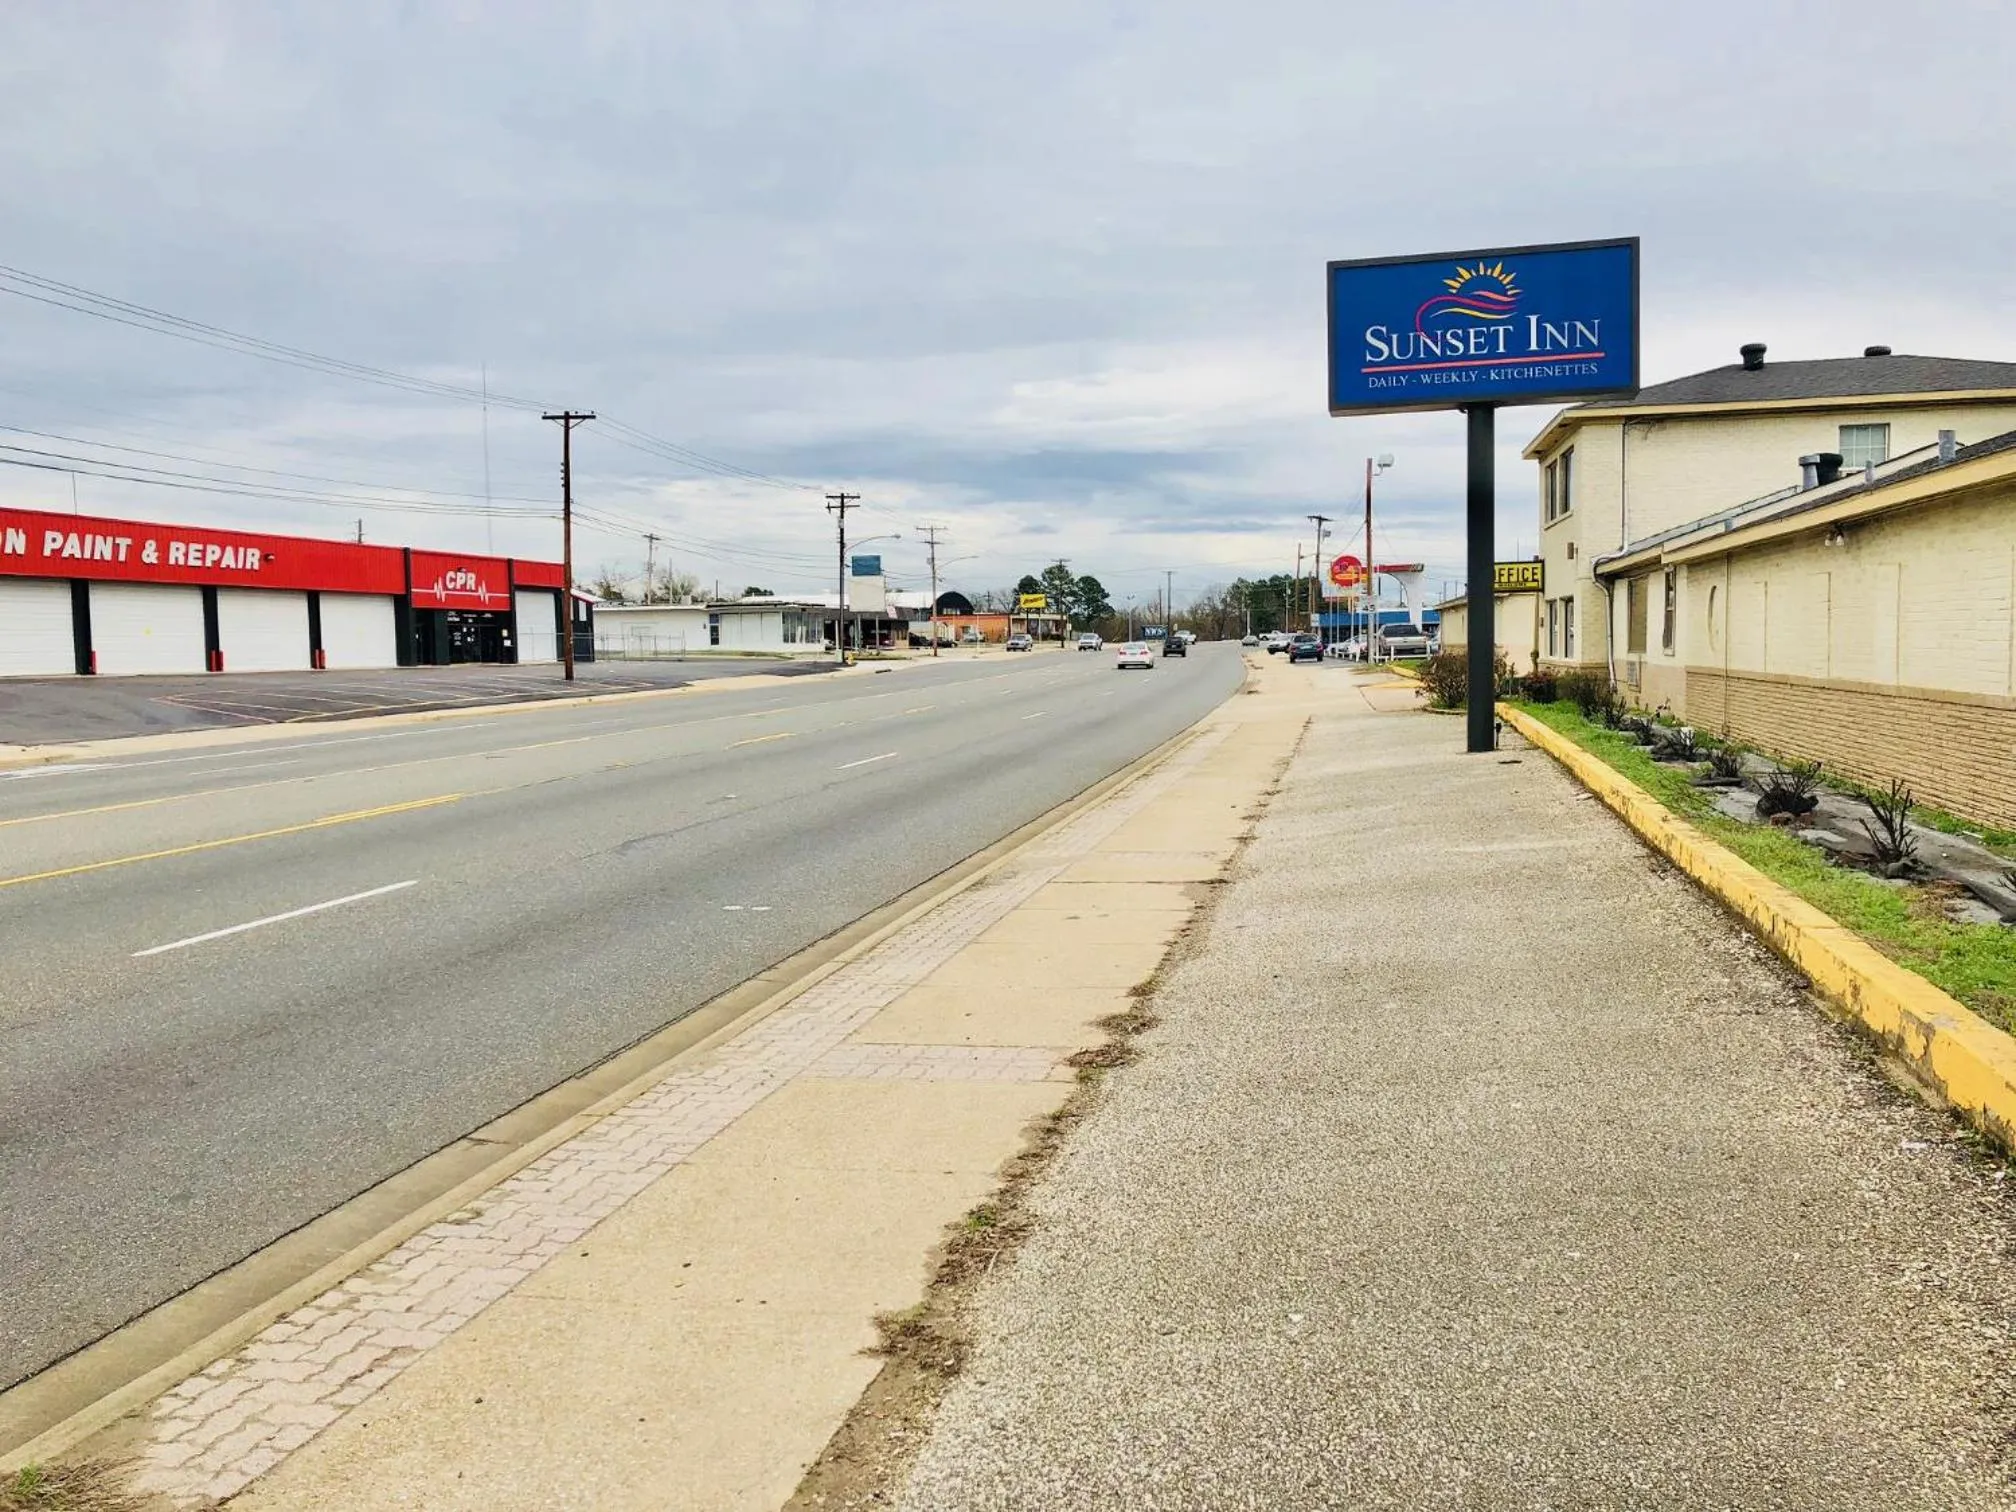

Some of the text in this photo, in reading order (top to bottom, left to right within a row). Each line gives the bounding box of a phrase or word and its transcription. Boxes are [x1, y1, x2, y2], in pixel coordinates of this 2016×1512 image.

[1365, 314, 1601, 362] SUNSET INN
[1368, 375, 1408, 388] DAILY
[1420, 370, 1479, 385] WEEKLY
[1490, 363, 1598, 381] KITCHENETTES
[0, 527, 260, 570] N PAINT & REPAIR
[446, 571, 475, 590] CPR
[1494, 567, 1539, 583] FFICE
